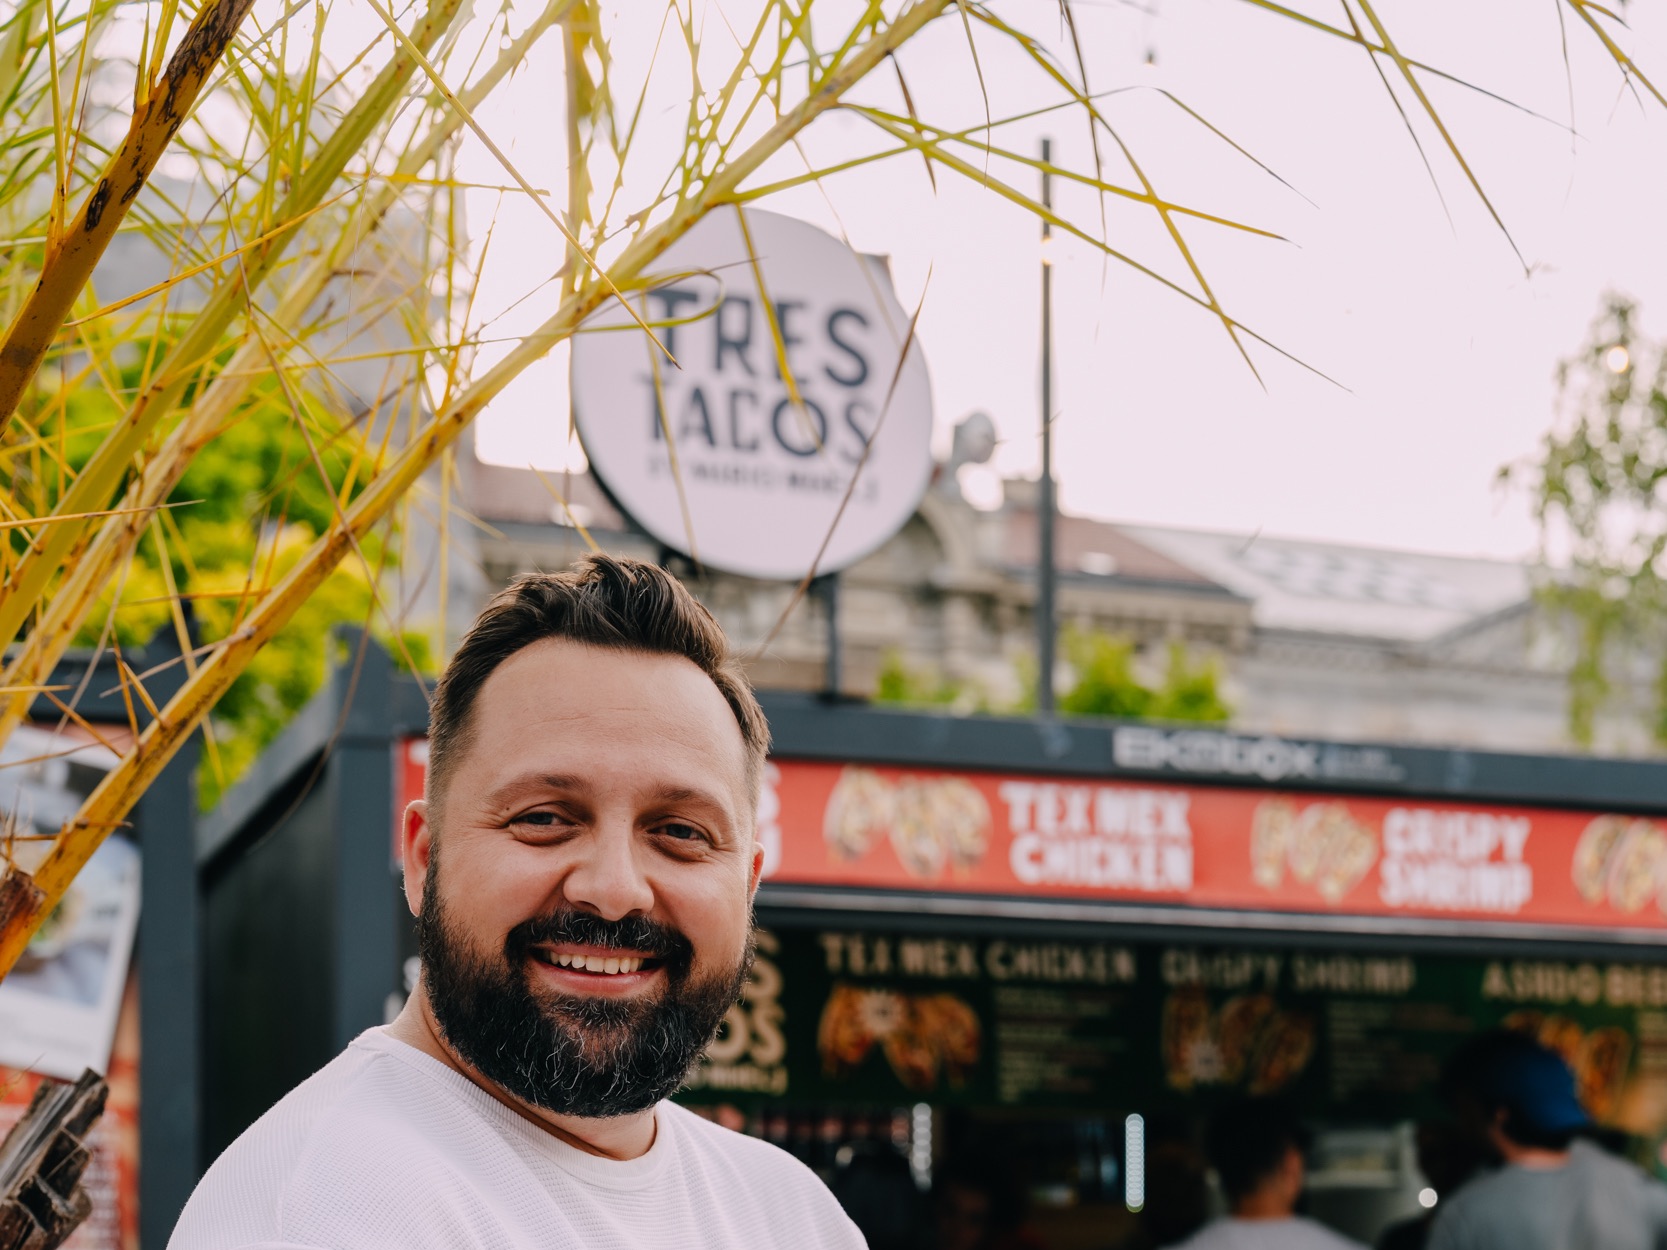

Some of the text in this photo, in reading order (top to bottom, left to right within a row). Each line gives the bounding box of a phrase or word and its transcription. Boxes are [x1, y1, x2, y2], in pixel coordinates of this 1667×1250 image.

[647, 287, 871, 389] TRES
[640, 373, 876, 464] TACOS
[998, 781, 1192, 838] TEX MEX
[1009, 831, 1194, 890] CHICKEN
[1378, 855, 1533, 914] SHRIMP
[985, 941, 1136, 983] CHICKEN
